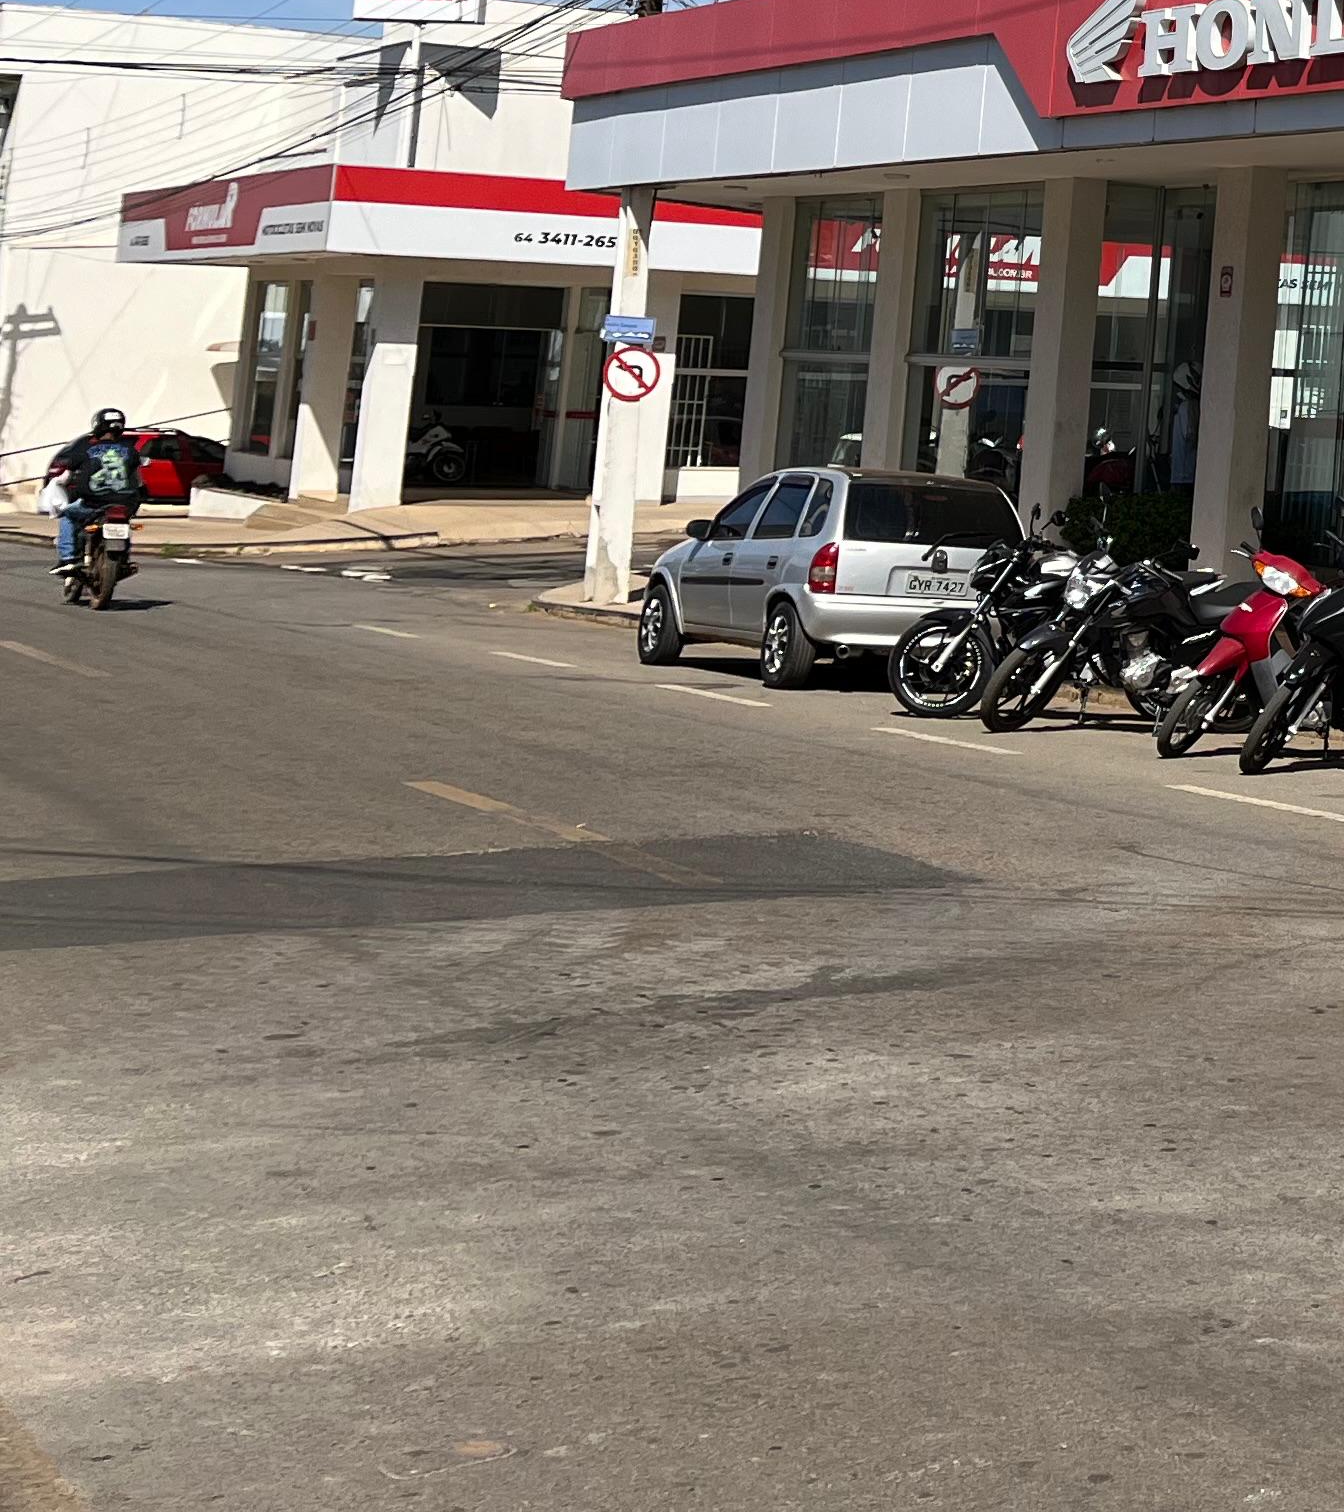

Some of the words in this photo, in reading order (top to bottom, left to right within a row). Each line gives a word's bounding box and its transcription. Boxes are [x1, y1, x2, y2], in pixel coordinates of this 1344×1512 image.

[514, 232, 534, 244] 64
[538, 232, 617, 248] 3411-265
[936, 581, 965, 593] 7427
